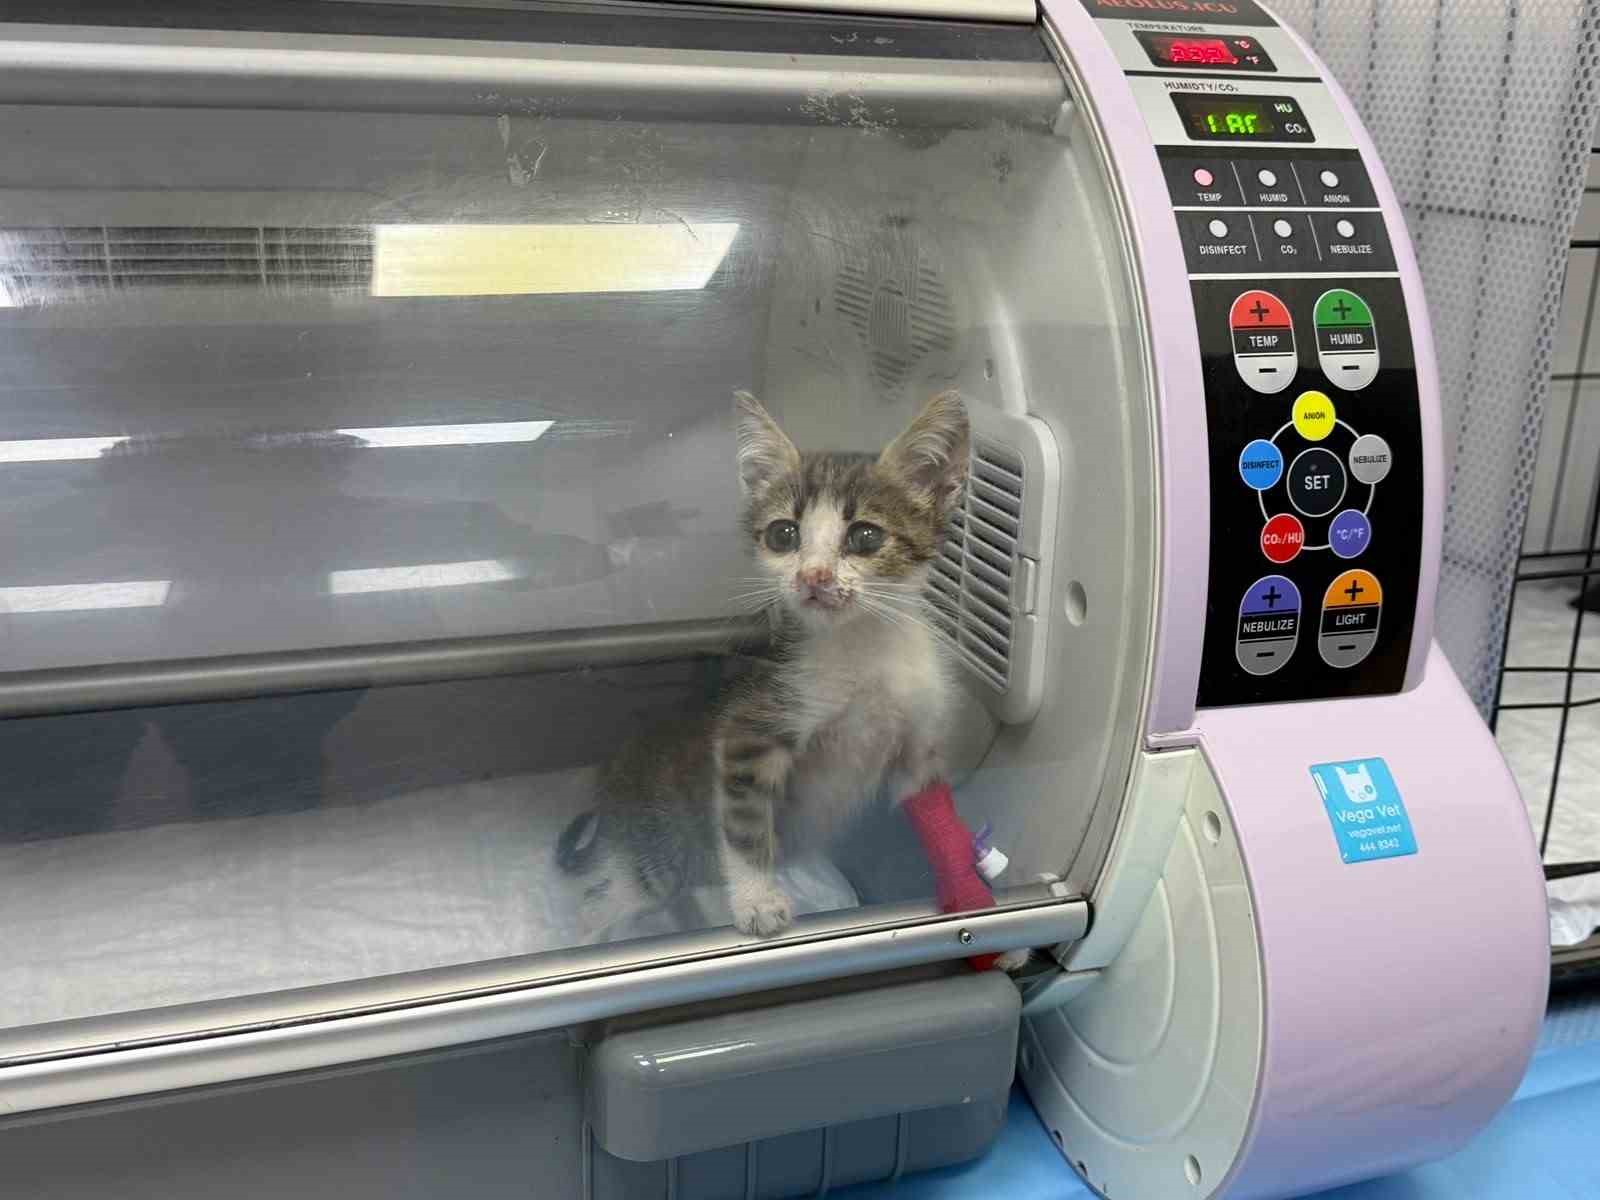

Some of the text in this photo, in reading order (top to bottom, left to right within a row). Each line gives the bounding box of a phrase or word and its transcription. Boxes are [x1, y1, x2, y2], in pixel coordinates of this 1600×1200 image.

[1127, 22, 1207, 32] TEMPERATURE
[1274, 103, 1293, 114] HU
[1197, 193, 1223, 202] TEMP
[1259, 193, 1289, 203] HUMID
[1323, 194, 1351, 204] ANION
[1199, 245, 1248, 256] DISINFECT
[1329, 245, 1374, 255] NEBULIZE
[1249, 336, 1280, 347] TEMP
[1329, 333, 1364, 345] HUMID
[1303, 411, 1326, 421] ANION
[1242, 459, 1280, 470] DISINFECT
[1352, 454, 1388, 464] NEBULIZE
[1304, 475, 1331, 491] SET
[1335, 613, 1367, 626] LIGHT
[1243, 618, 1295, 633] NEBULIZE
[1336, 804, 1401, 824] Vega Vet
[1359, 838, 1401, 852] 444 8342
